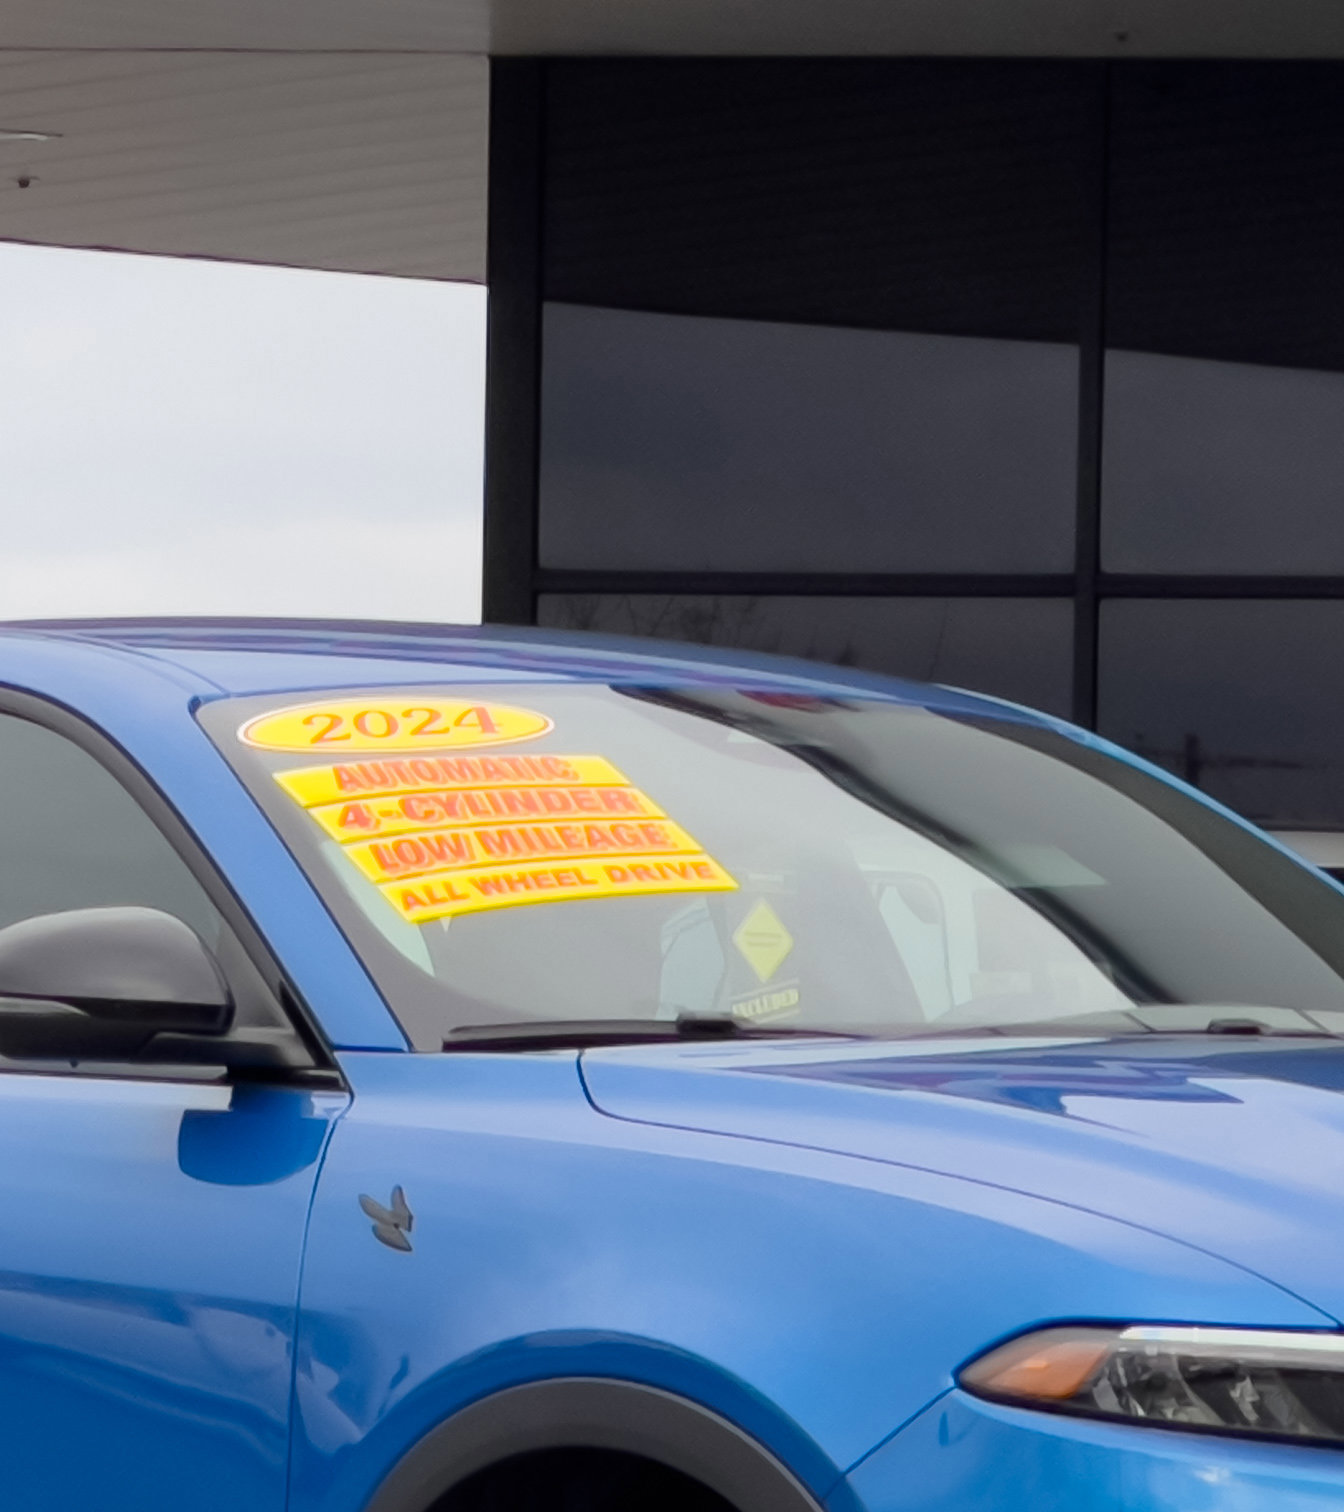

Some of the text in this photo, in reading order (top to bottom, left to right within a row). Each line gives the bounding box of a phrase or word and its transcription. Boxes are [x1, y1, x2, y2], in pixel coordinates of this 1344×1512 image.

[301, 705, 504, 745] 2024
[332, 755, 580, 792] AUTOMATIC
[337, 787, 646, 831] 4-CYLINDER
[369, 821, 678, 875] LOW MILEAGE
[399, 860, 718, 912] ALL WHEEL DRIVE
